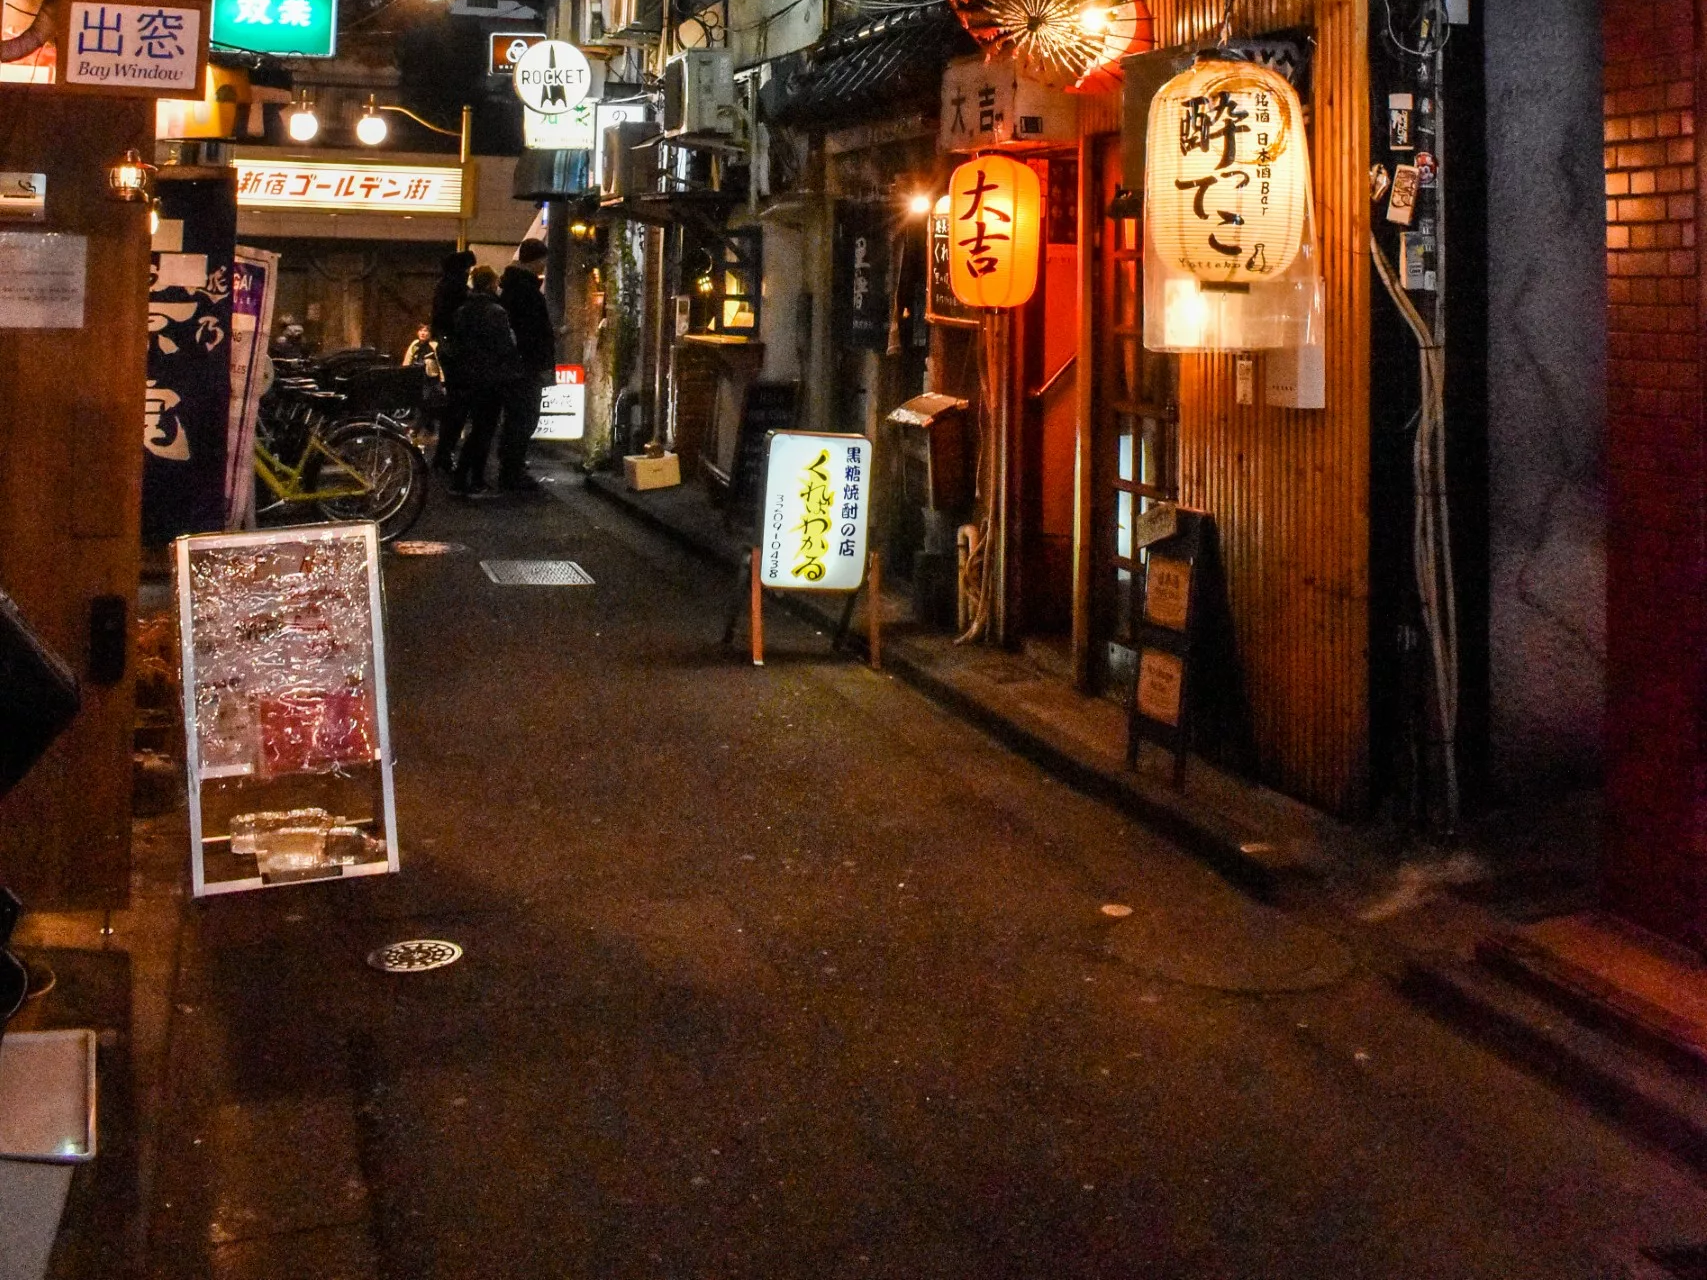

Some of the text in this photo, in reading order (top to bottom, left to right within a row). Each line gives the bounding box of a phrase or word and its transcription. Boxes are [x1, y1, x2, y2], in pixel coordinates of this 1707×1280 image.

[78, 6, 185, 59] 出窓
[79, 61, 183, 81] Bay Window
[521, 69, 585, 85] ROCKET
[238, 171, 432, 200] 新宿ゴールデン街
[957, 170, 1011, 279] 大吉
[796, 453, 830, 580] くればわかる
[839, 446, 861, 557] 黒糖焼酎の店
